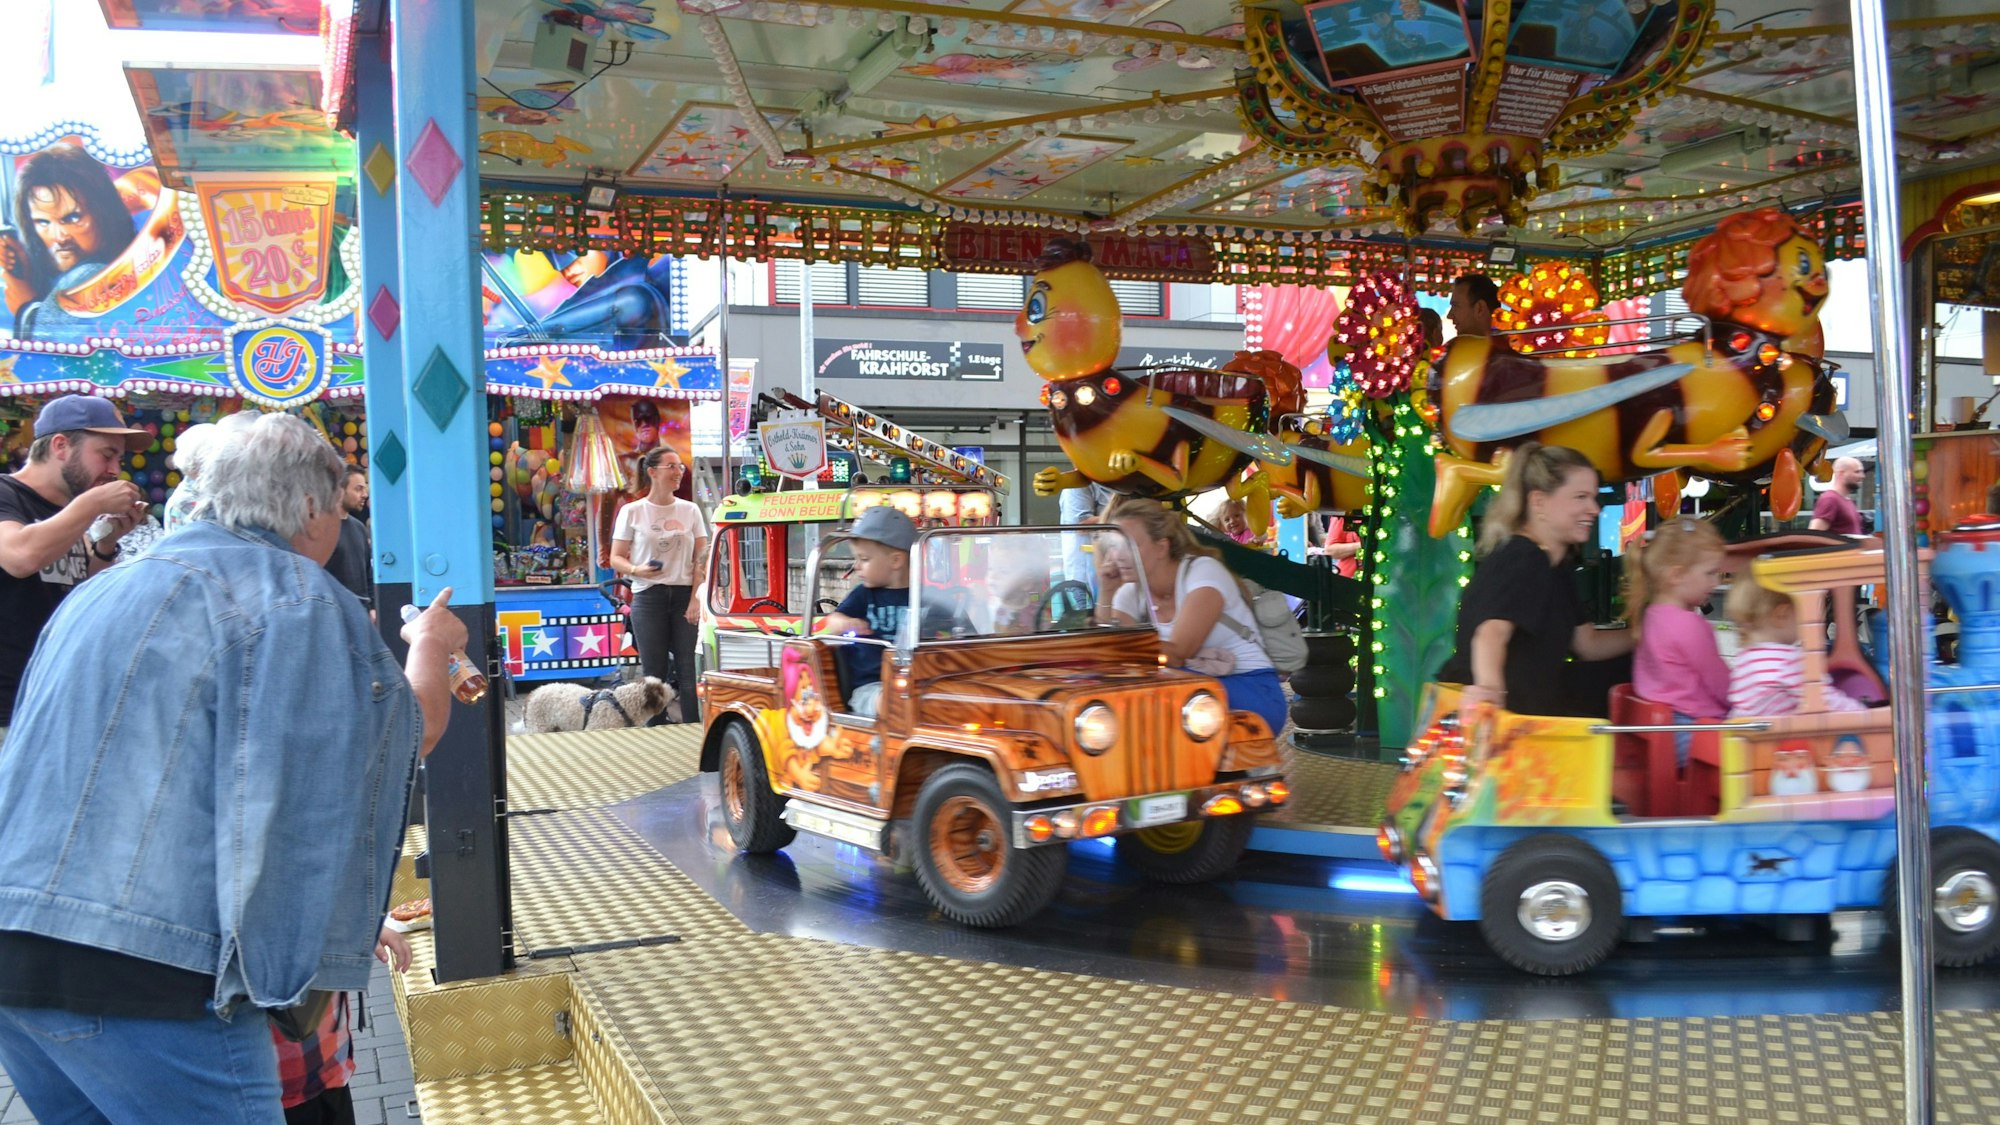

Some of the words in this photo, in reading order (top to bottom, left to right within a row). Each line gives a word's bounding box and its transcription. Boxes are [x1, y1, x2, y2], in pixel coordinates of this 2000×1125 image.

[1508, 64, 1527, 75] Nur
[1525, 67, 1543, 78] für
[1542, 69, 1579, 84] Kinder!
[1373, 83, 1393, 95] Signal
[1392, 78, 1422, 91] Fahrbahn
[222, 205, 263, 246] 15
[262, 207, 316, 237] Chips
[957, 226, 1065, 262] BIEN
[1100, 234, 1195, 270] MAJA
[851, 349, 931, 362] FAHRSCHULE-
[859, 361, 950, 377] KRAHFORST
[759, 508, 796, 518] BONN
[800, 505, 842, 517] BEUEL
